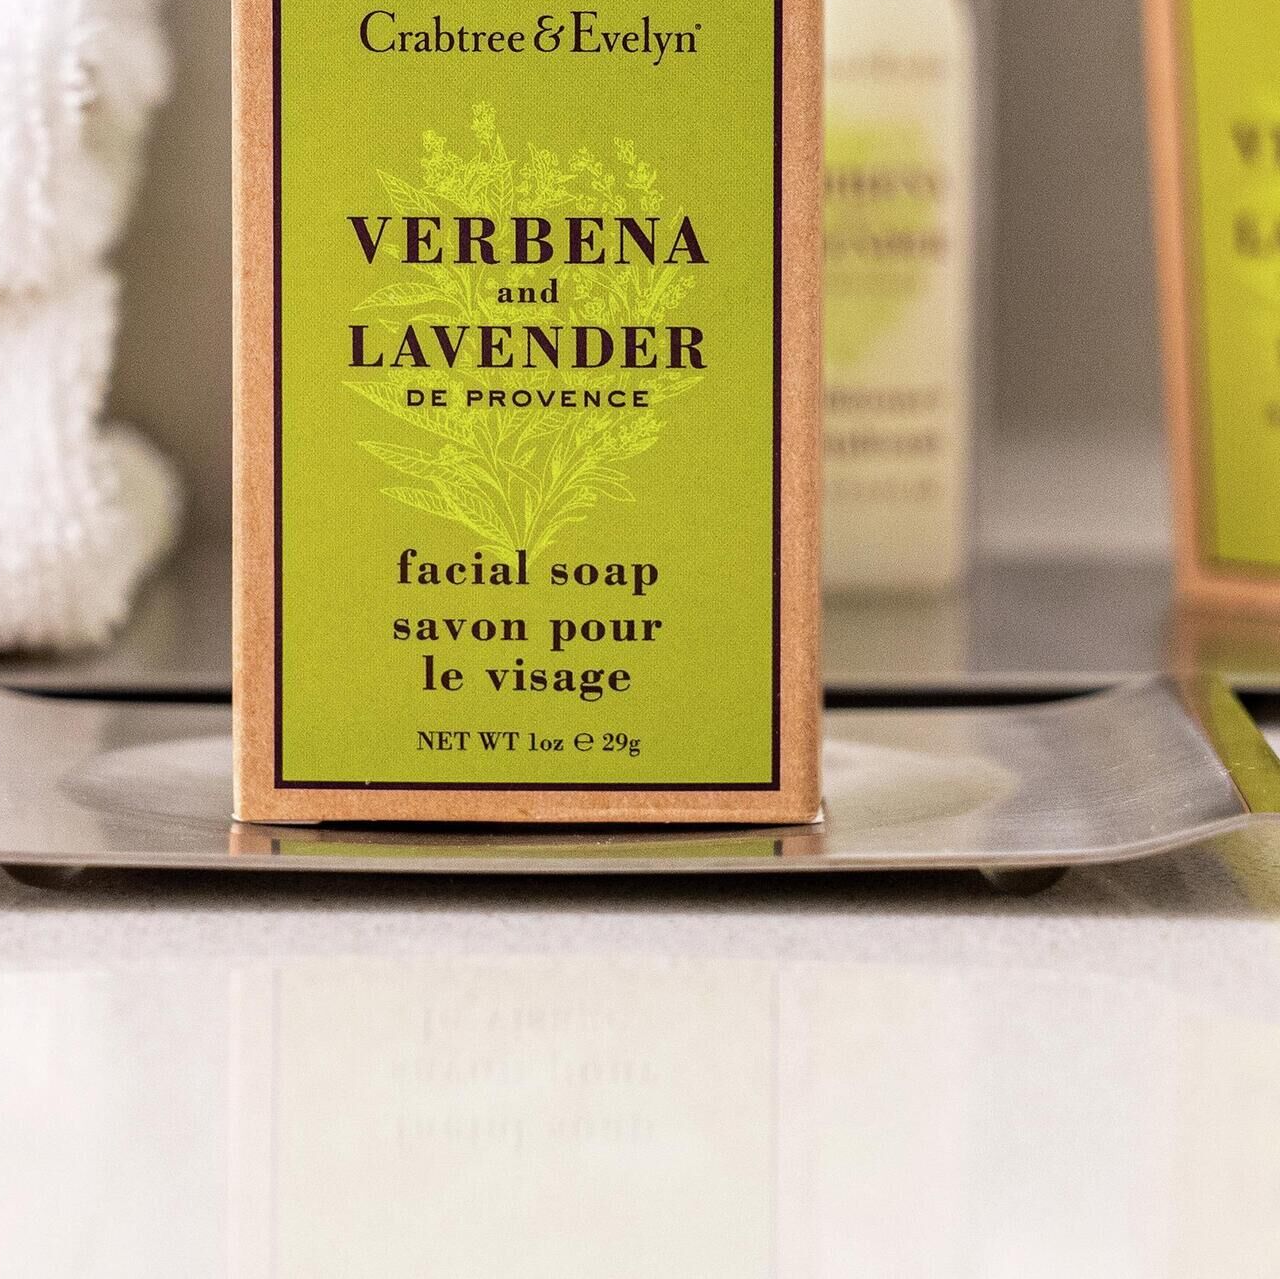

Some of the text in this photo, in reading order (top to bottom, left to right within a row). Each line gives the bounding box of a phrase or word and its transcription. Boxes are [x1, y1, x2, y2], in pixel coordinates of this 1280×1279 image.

[359, 10, 525, 53] Crabtree
[533, 14, 565, 53] &
[346, 215, 710, 266] VERBENA
[497, 277, 559, 304] and
[348, 324, 708, 370] LAVENDER
[406, 388, 650, 409] DE PROVENCE
[396, 548, 659, 596] facial soap
[392, 617, 663, 652] savon pour
[422, 654, 632, 703] le visage
[416, 730, 471, 752] NET
[477, 730, 520, 752] WT
[602, 732, 642, 758] 29g
